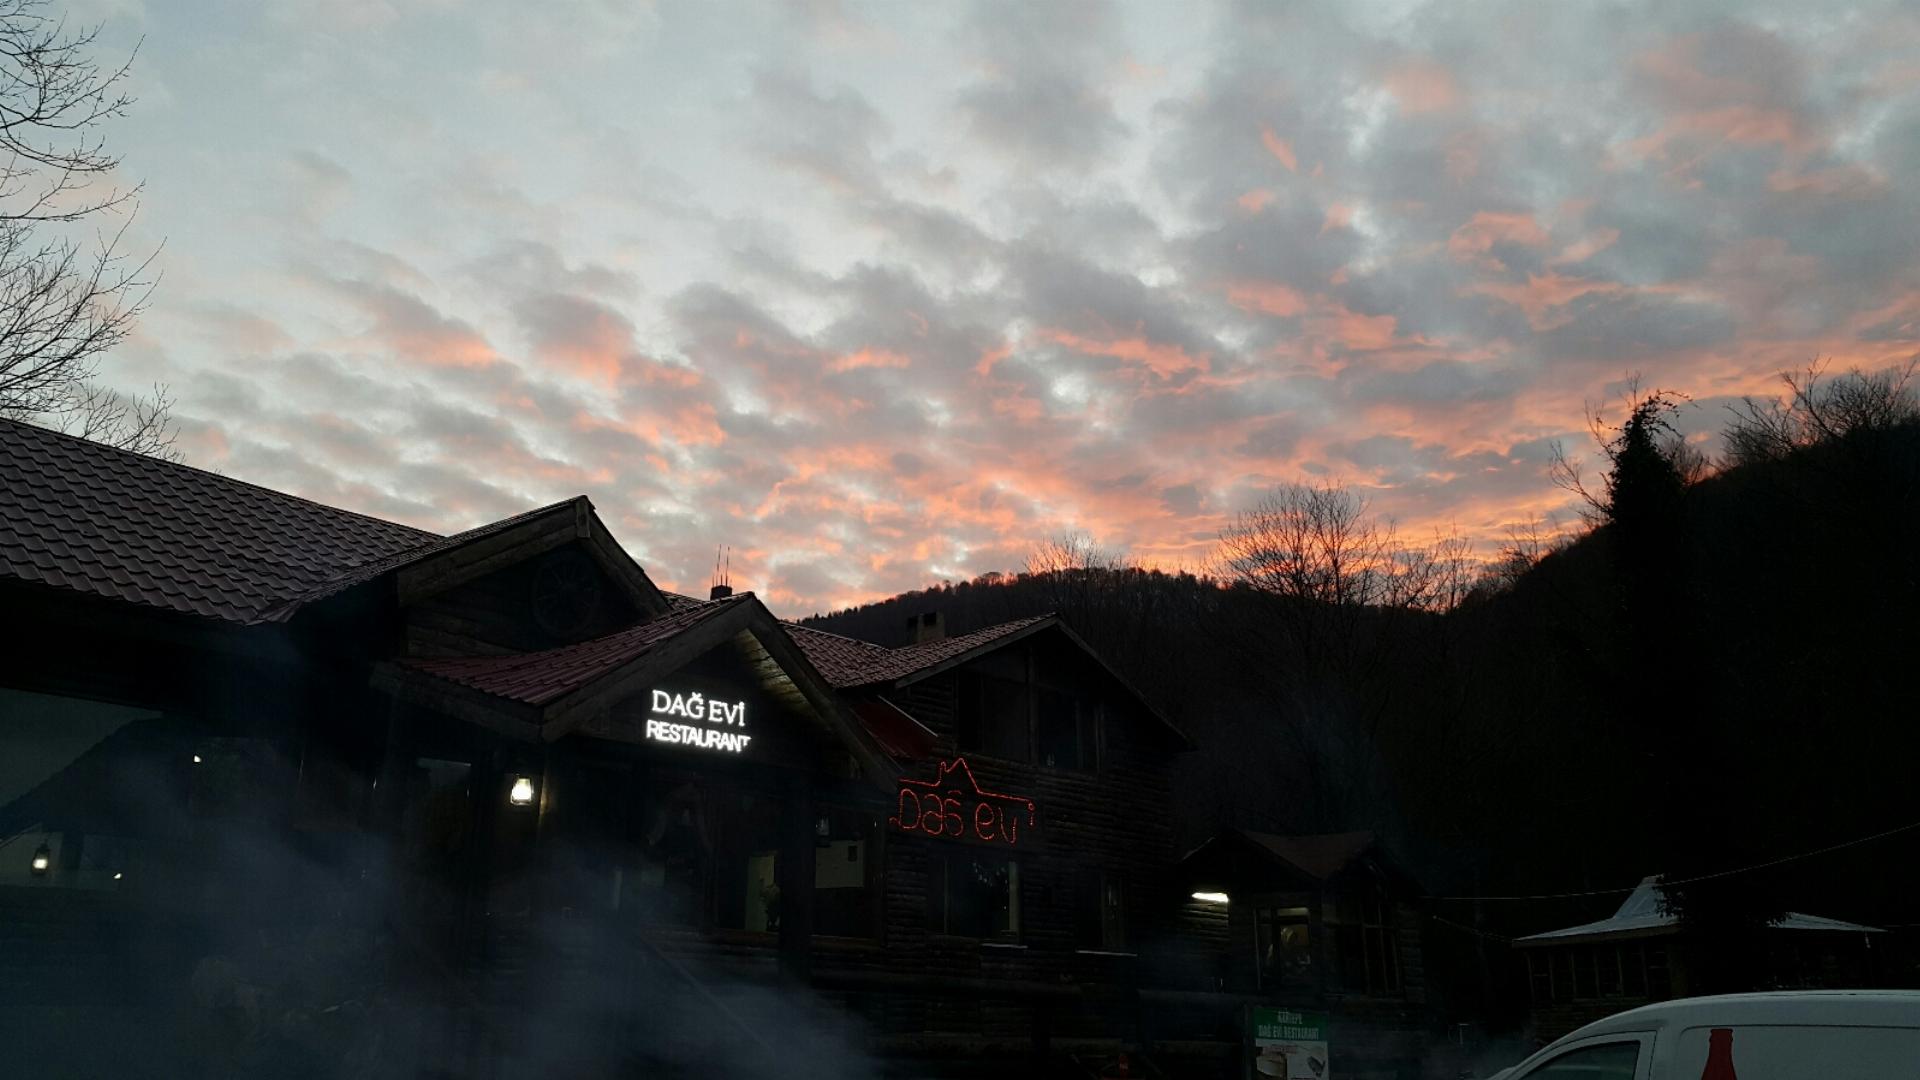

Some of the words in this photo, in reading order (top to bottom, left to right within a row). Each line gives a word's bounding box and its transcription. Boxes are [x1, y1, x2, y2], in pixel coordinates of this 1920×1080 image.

[652, 689, 706, 719] DAĞ
[708, 699, 745, 727] EVİ
[646, 719, 752, 753] RESTAURANT
